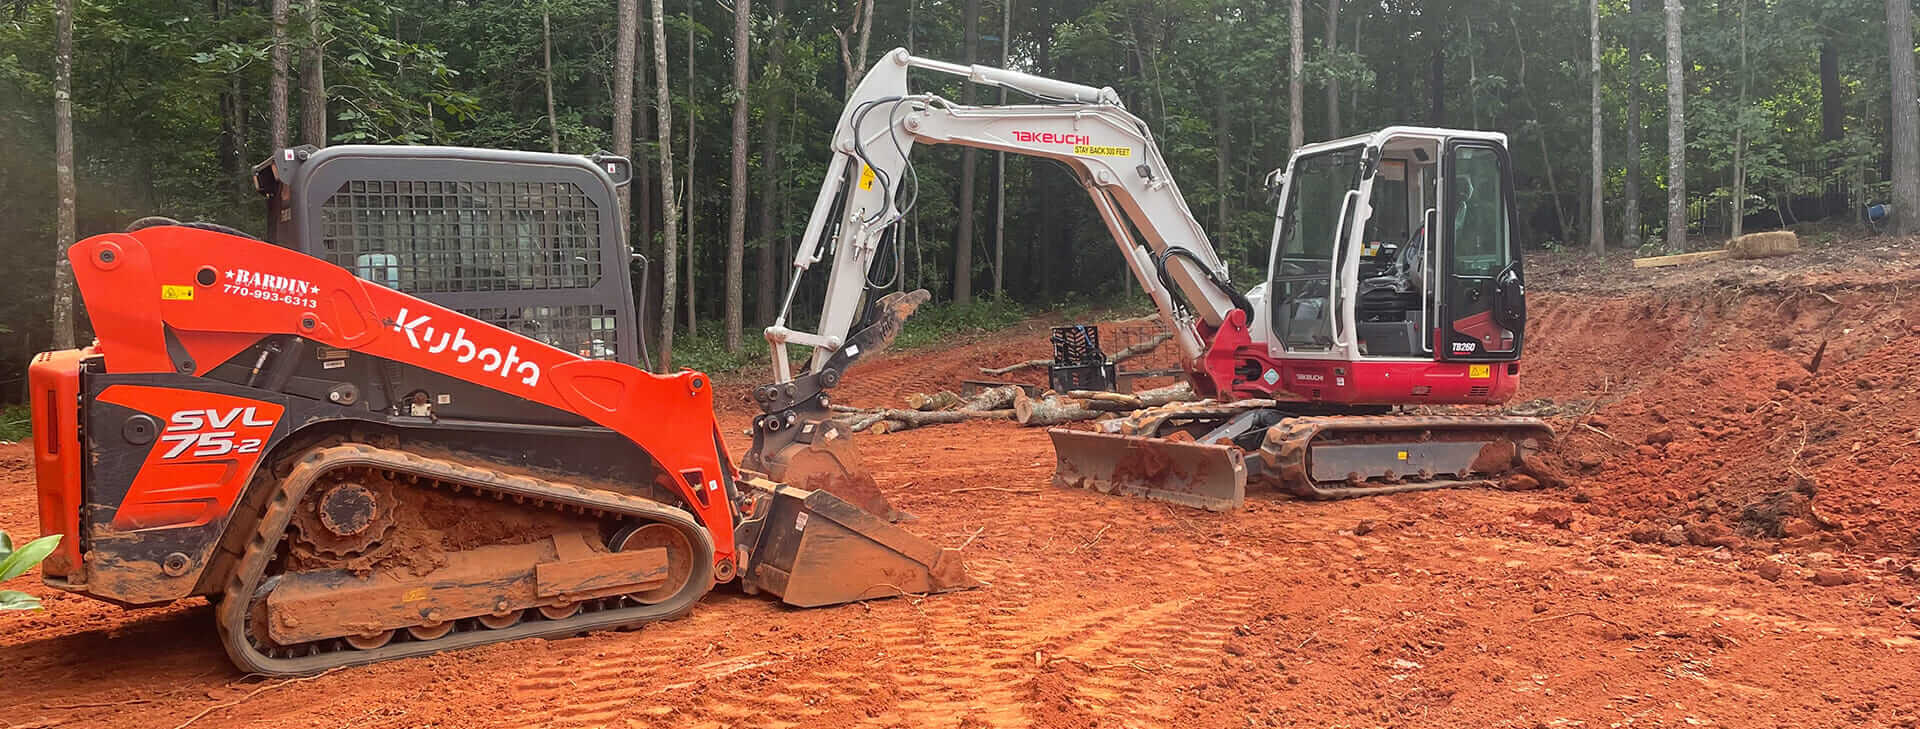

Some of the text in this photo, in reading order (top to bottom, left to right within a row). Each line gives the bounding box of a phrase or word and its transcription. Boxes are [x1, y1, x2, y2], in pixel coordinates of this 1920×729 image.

[1116, 148, 1130, 156] FEET
[235, 269, 309, 294] BARDIN
[223, 284, 317, 308] 770-993-6313
[393, 308, 540, 387] Kubota
[1452, 342, 1476, 352] TB260
[167, 406, 274, 432] SVL
[162, 432, 261, 459] 75-2
